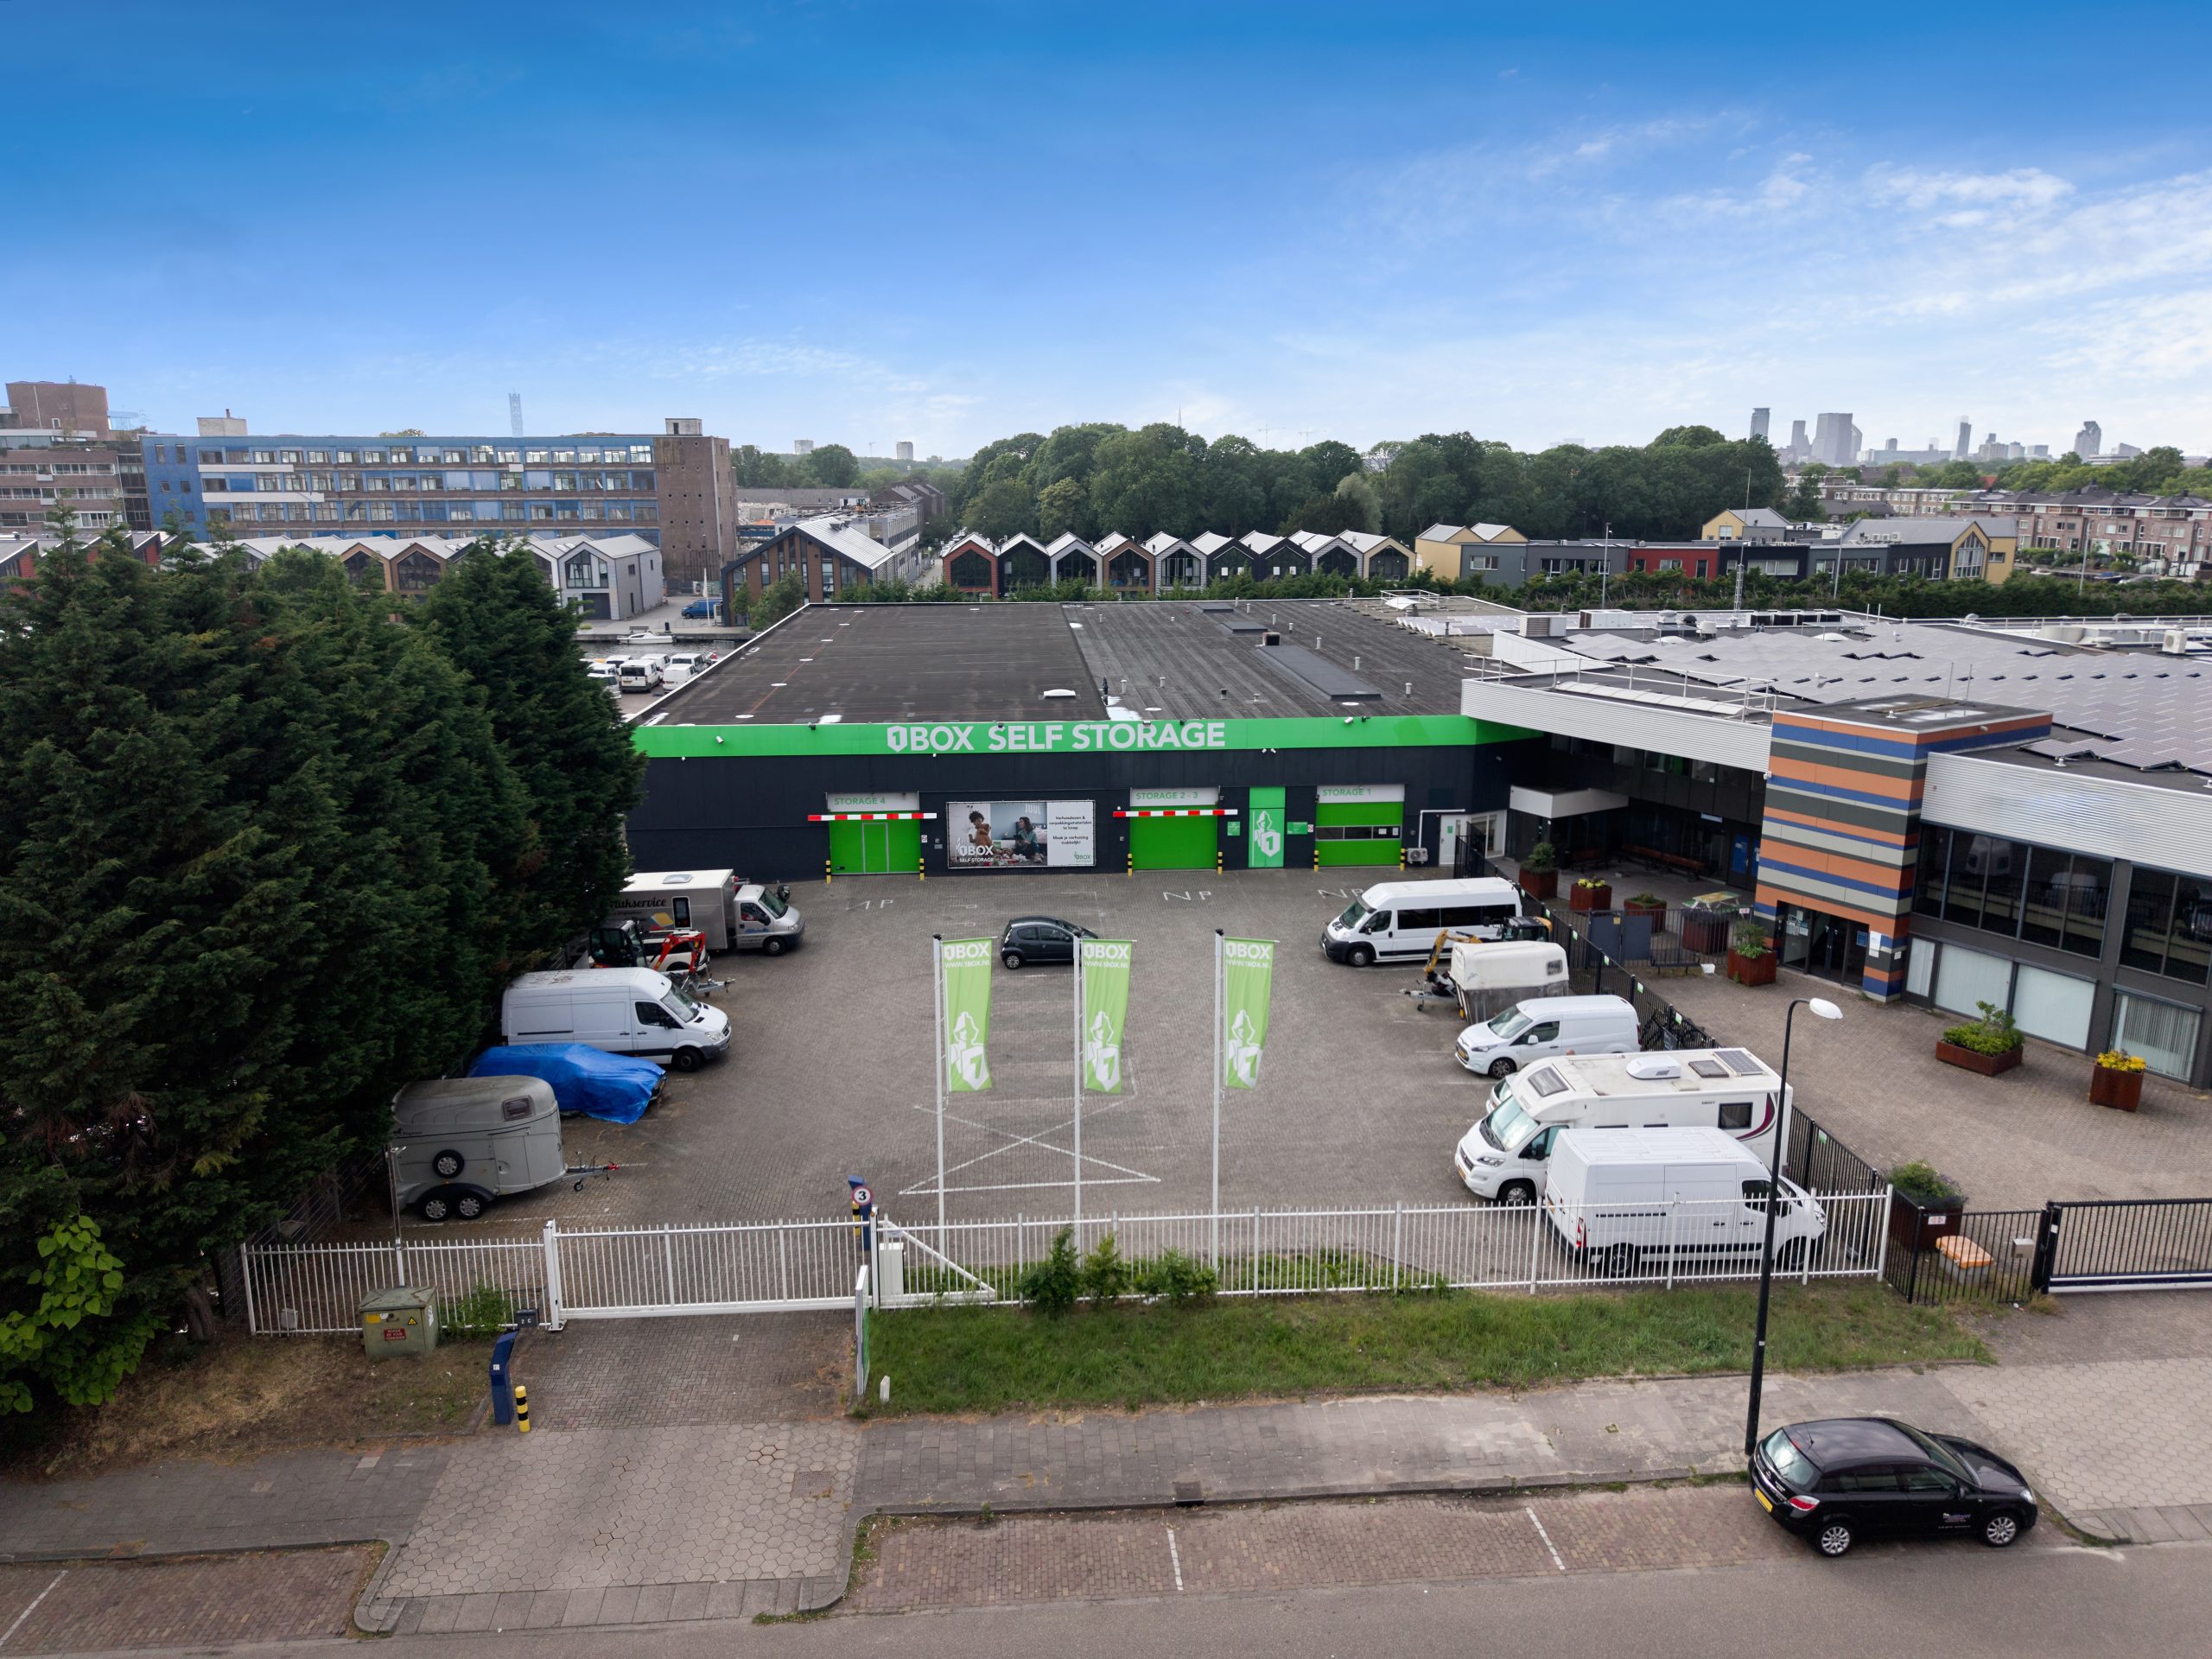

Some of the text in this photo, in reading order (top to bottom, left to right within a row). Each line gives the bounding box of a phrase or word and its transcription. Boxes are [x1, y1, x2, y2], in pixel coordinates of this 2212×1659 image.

[887, 722, 1225, 753] 1BOX SELF STORAGE
[858, 1191, 867, 1201] 3
